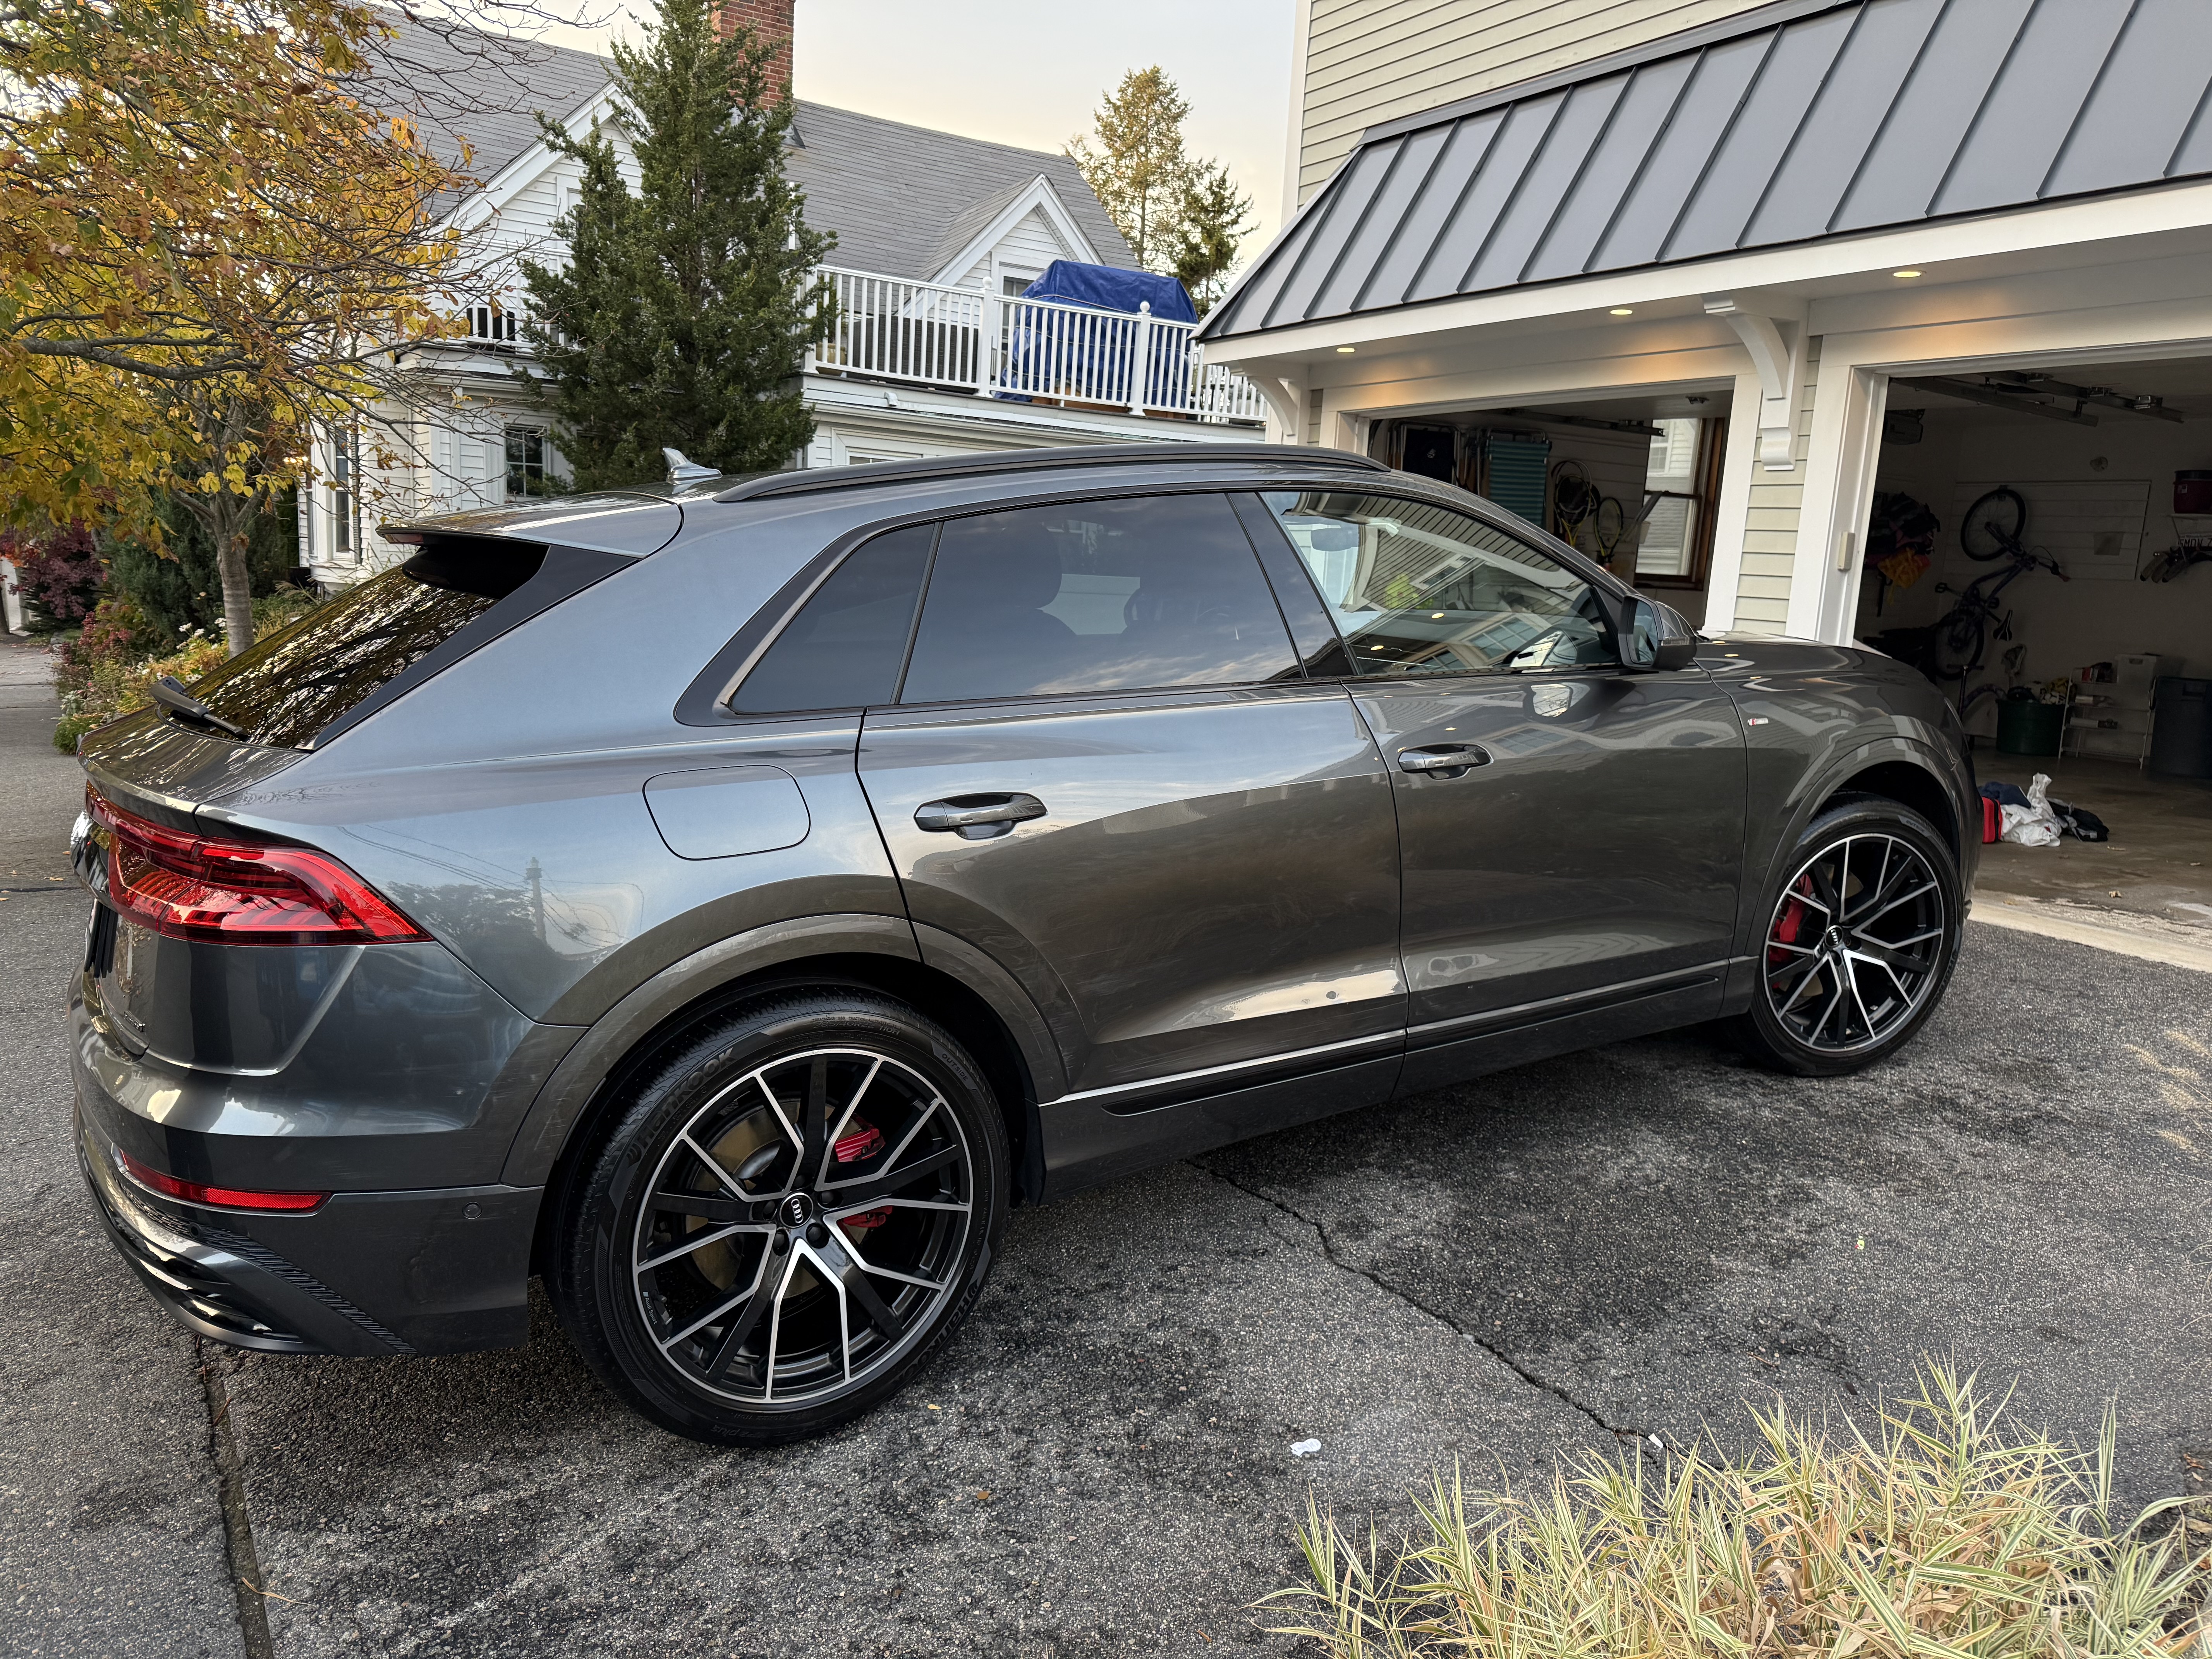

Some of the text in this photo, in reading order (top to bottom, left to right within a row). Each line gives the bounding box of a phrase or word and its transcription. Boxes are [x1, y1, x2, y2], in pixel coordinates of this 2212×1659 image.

[879, 1025, 900, 1035] 110H
[942, 1053, 968, 1081] OUTSIDE
[649, 1310, 657, 1324] Sport
